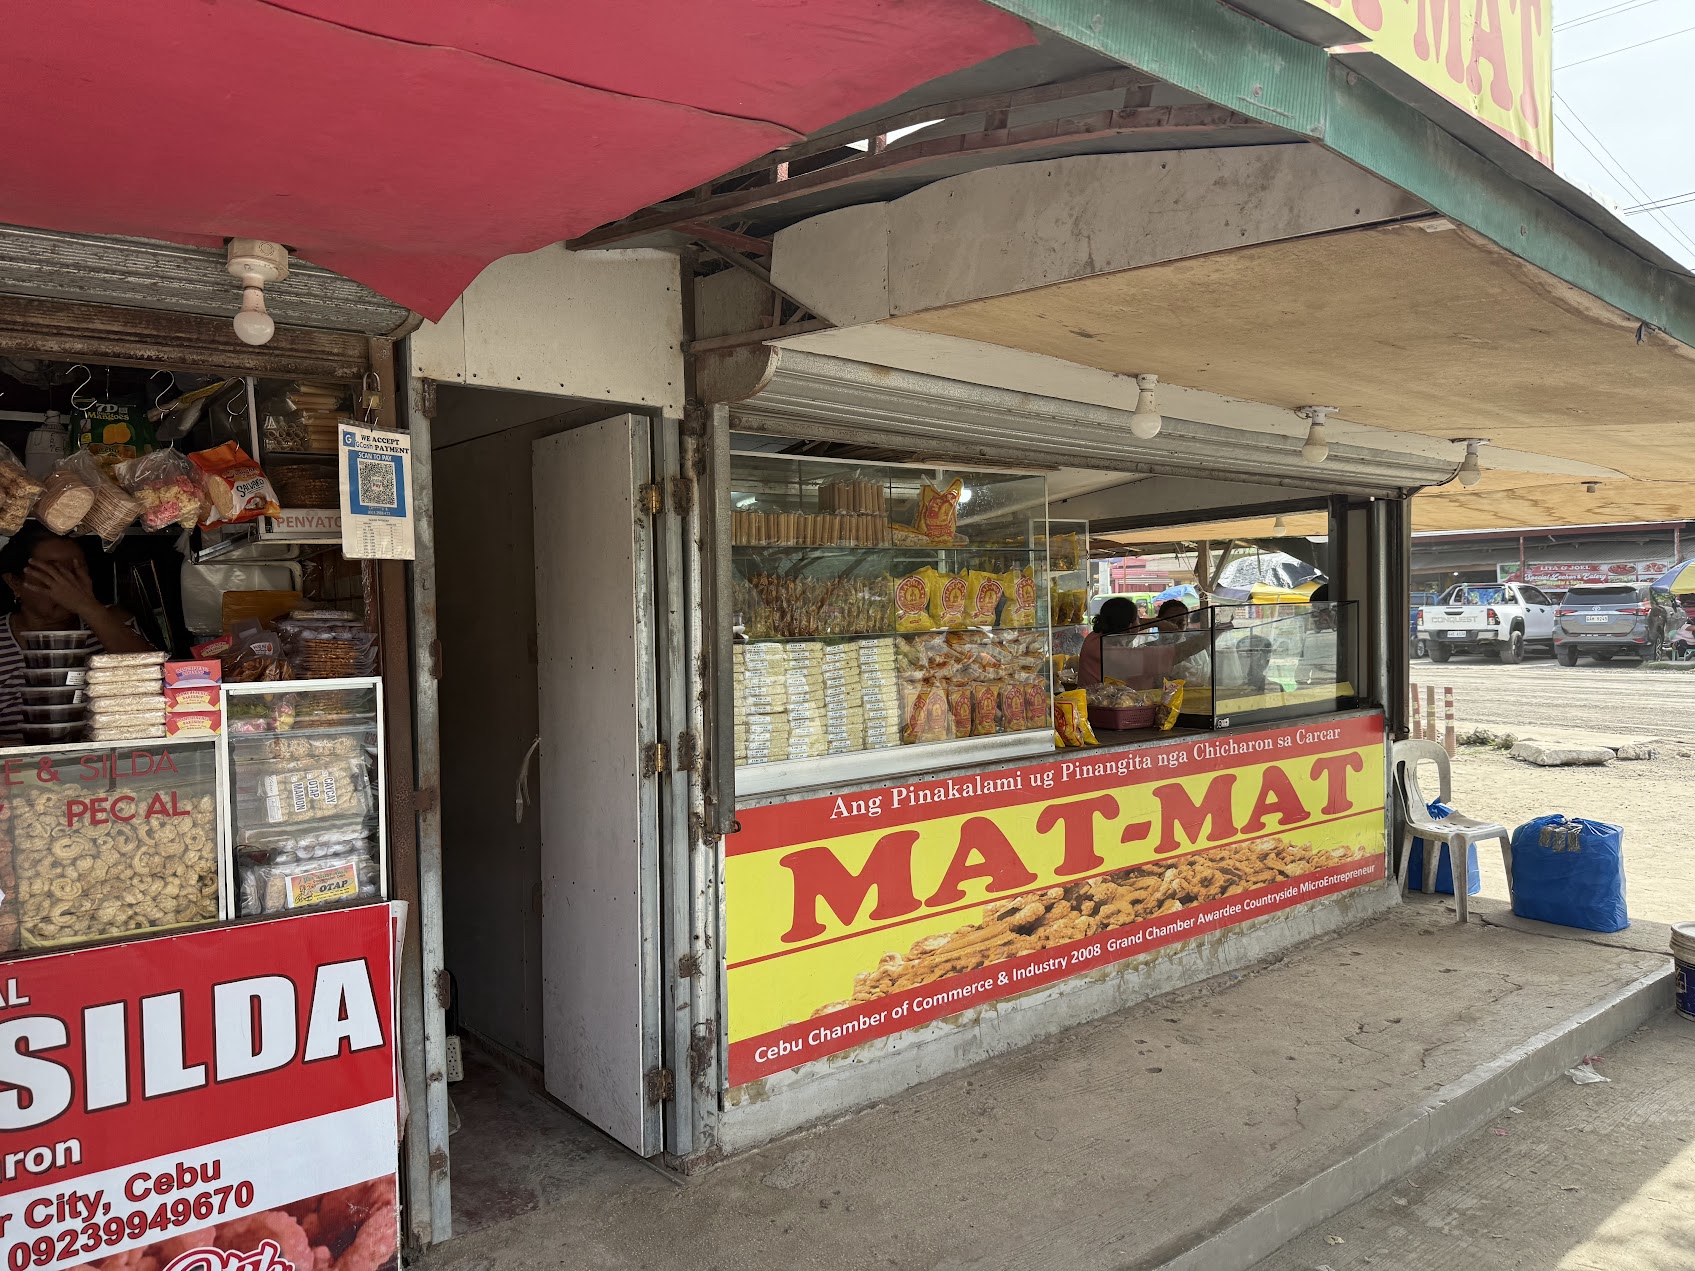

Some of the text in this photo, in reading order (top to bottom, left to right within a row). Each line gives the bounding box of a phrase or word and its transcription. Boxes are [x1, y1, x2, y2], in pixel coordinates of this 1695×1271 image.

[95, 403, 118, 413] 7D
[355, 441, 410, 454] GCash PAYMENT
[361, 434, 400, 446] WE ACCEPT
[36, 756, 61, 783] &
[80, 750, 180, 781] SILDA
[830, 727, 1341, 821] Ang Pinakalami ug Pinangita nga Chicharon sa Carcar
[292, 783, 306, 811] MAMON
[308, 780, 320, 798] OTAP
[324, 777, 337, 803] CAYCAY
[779, 751, 1363, 943] MAT-MAT
[319, 879, 348, 893] OTAP
[754, 863, 1376, 1063] Cebu Chamber of Commerce & Industry 2008 Grand Chamber Awardee Countryside MicroEntrepreneur
[0, 957, 385, 1133] SILDA
[24, 1189, 111, 1231] City,
[124, 1159, 221, 1202] Cebu
[7, 1180, 254, 1271] 09239949670
